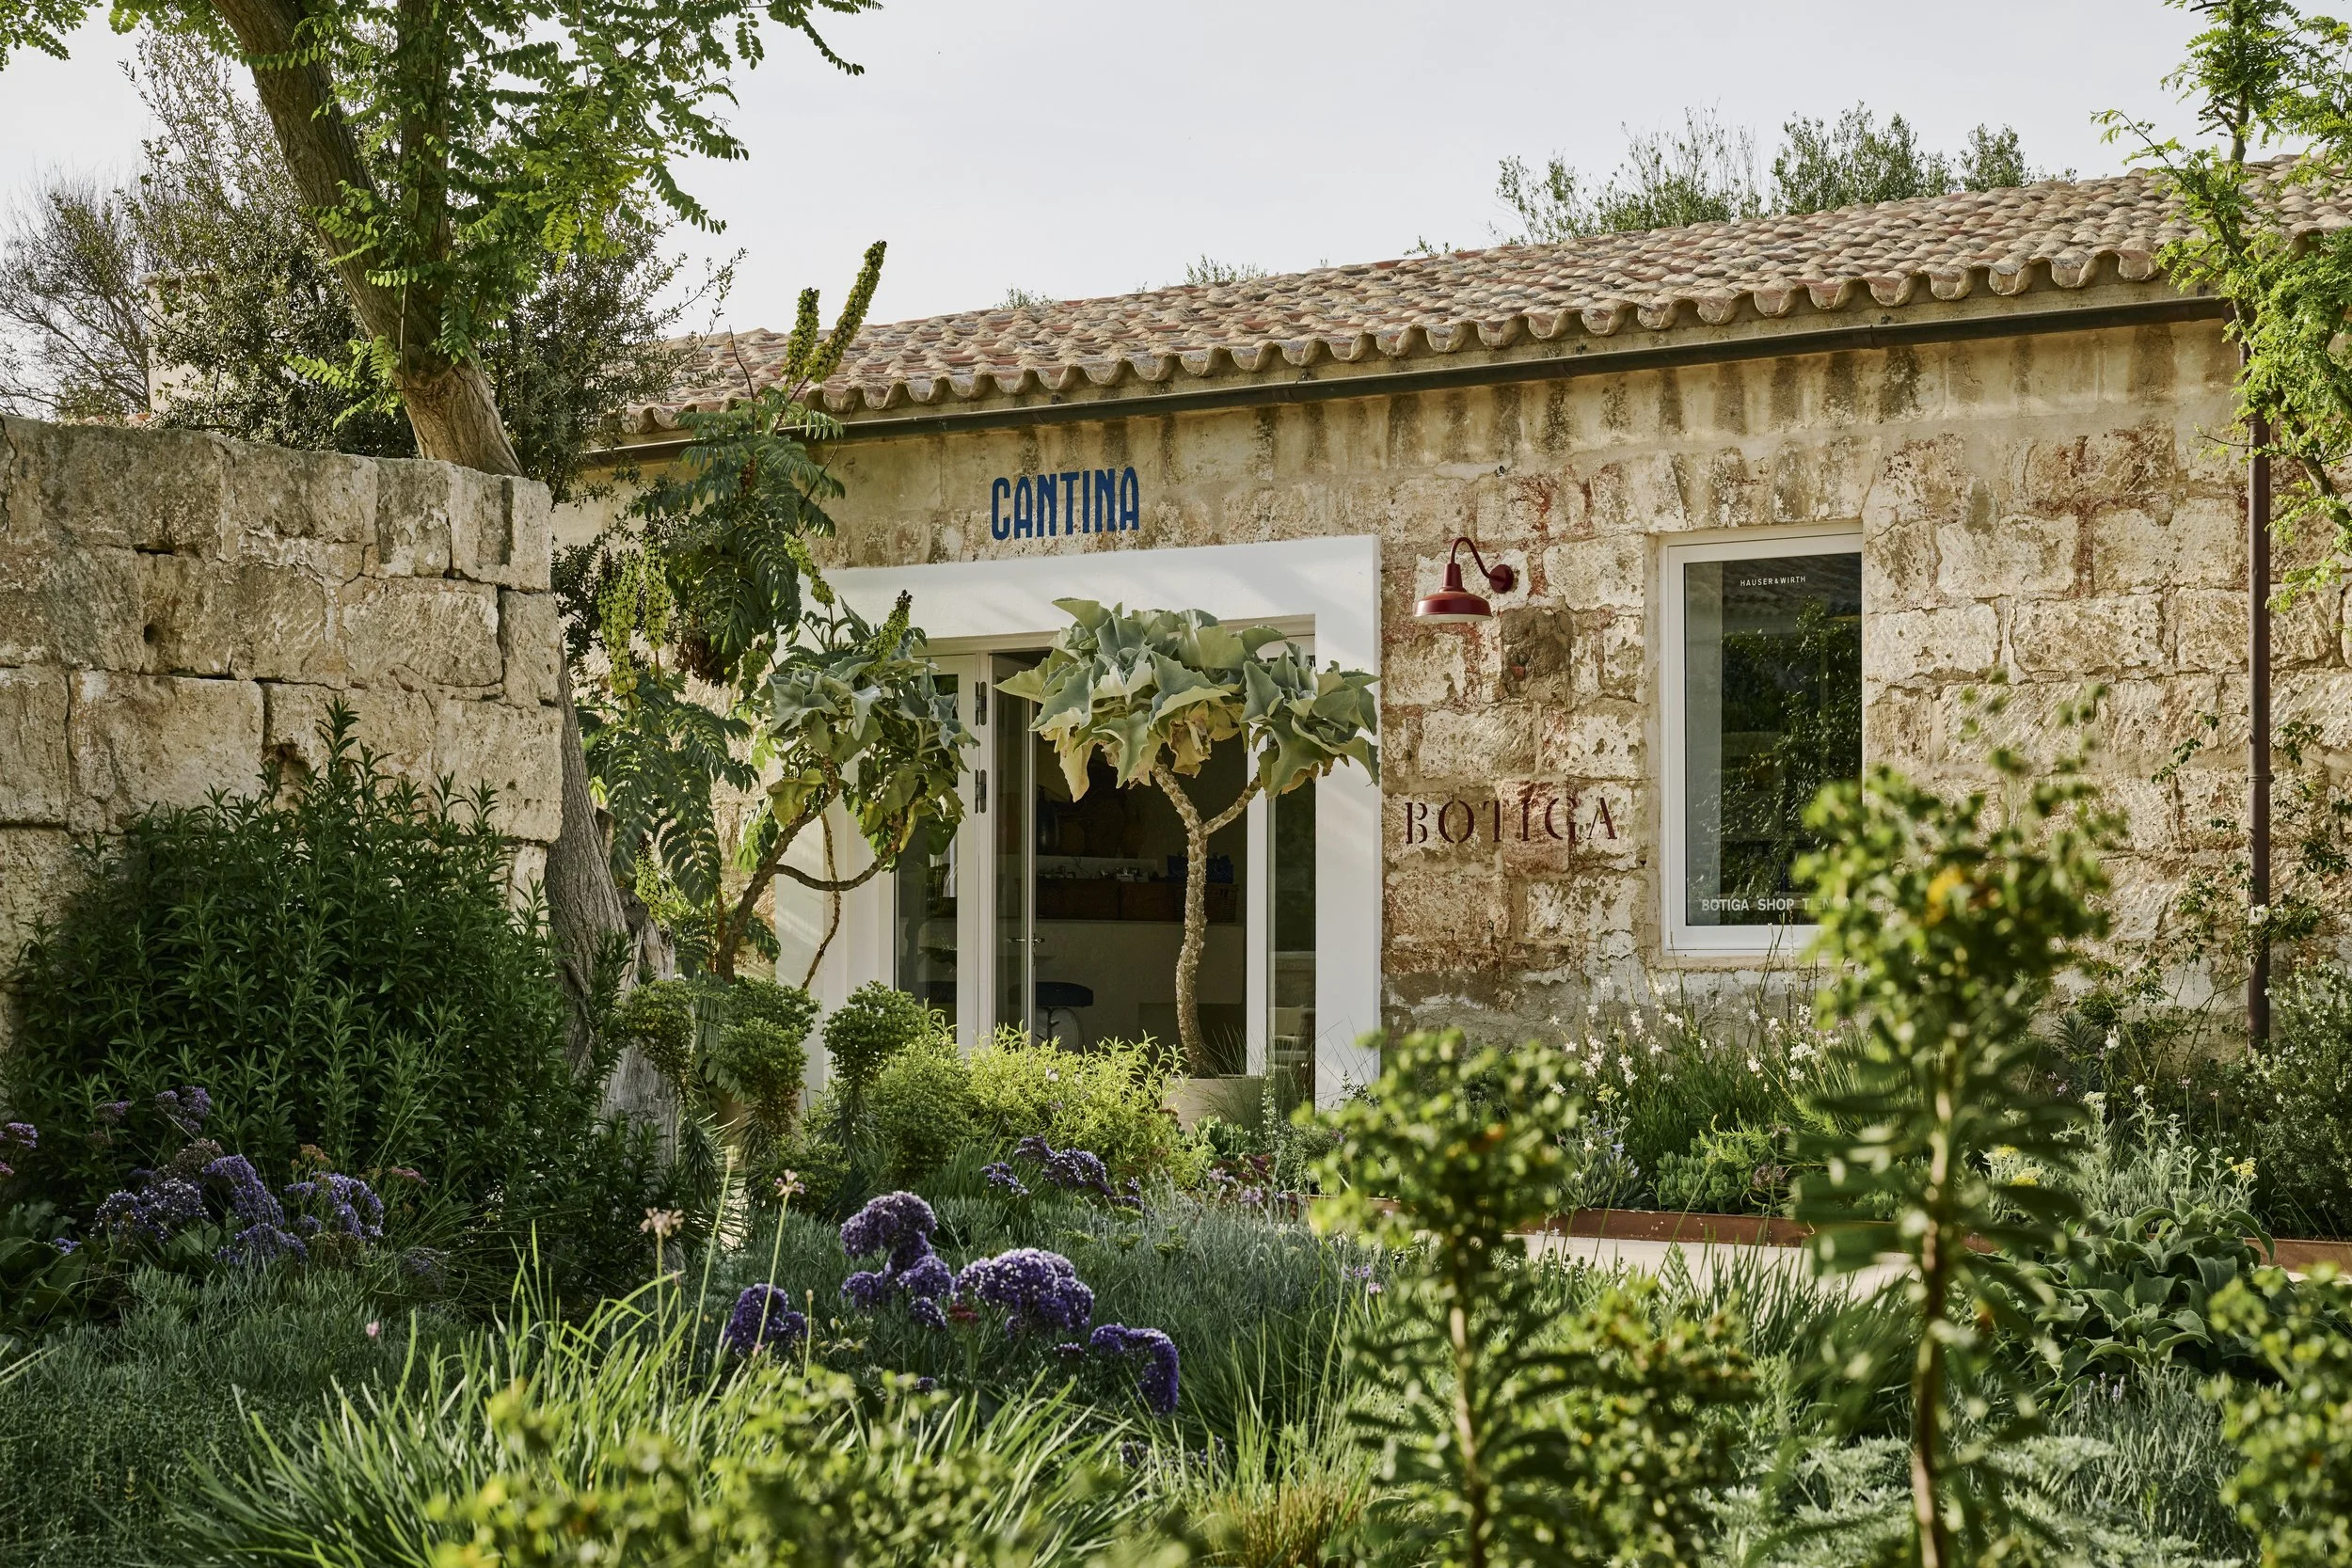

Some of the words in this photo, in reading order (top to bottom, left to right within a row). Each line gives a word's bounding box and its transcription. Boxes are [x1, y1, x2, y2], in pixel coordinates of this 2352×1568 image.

[992, 467, 1140, 540] CANTINA
[1405, 797, 1618, 844] BOTIGA
[1701, 897, 1750, 911] BOTIGA
[1757, 897, 1795, 911] SHOP
